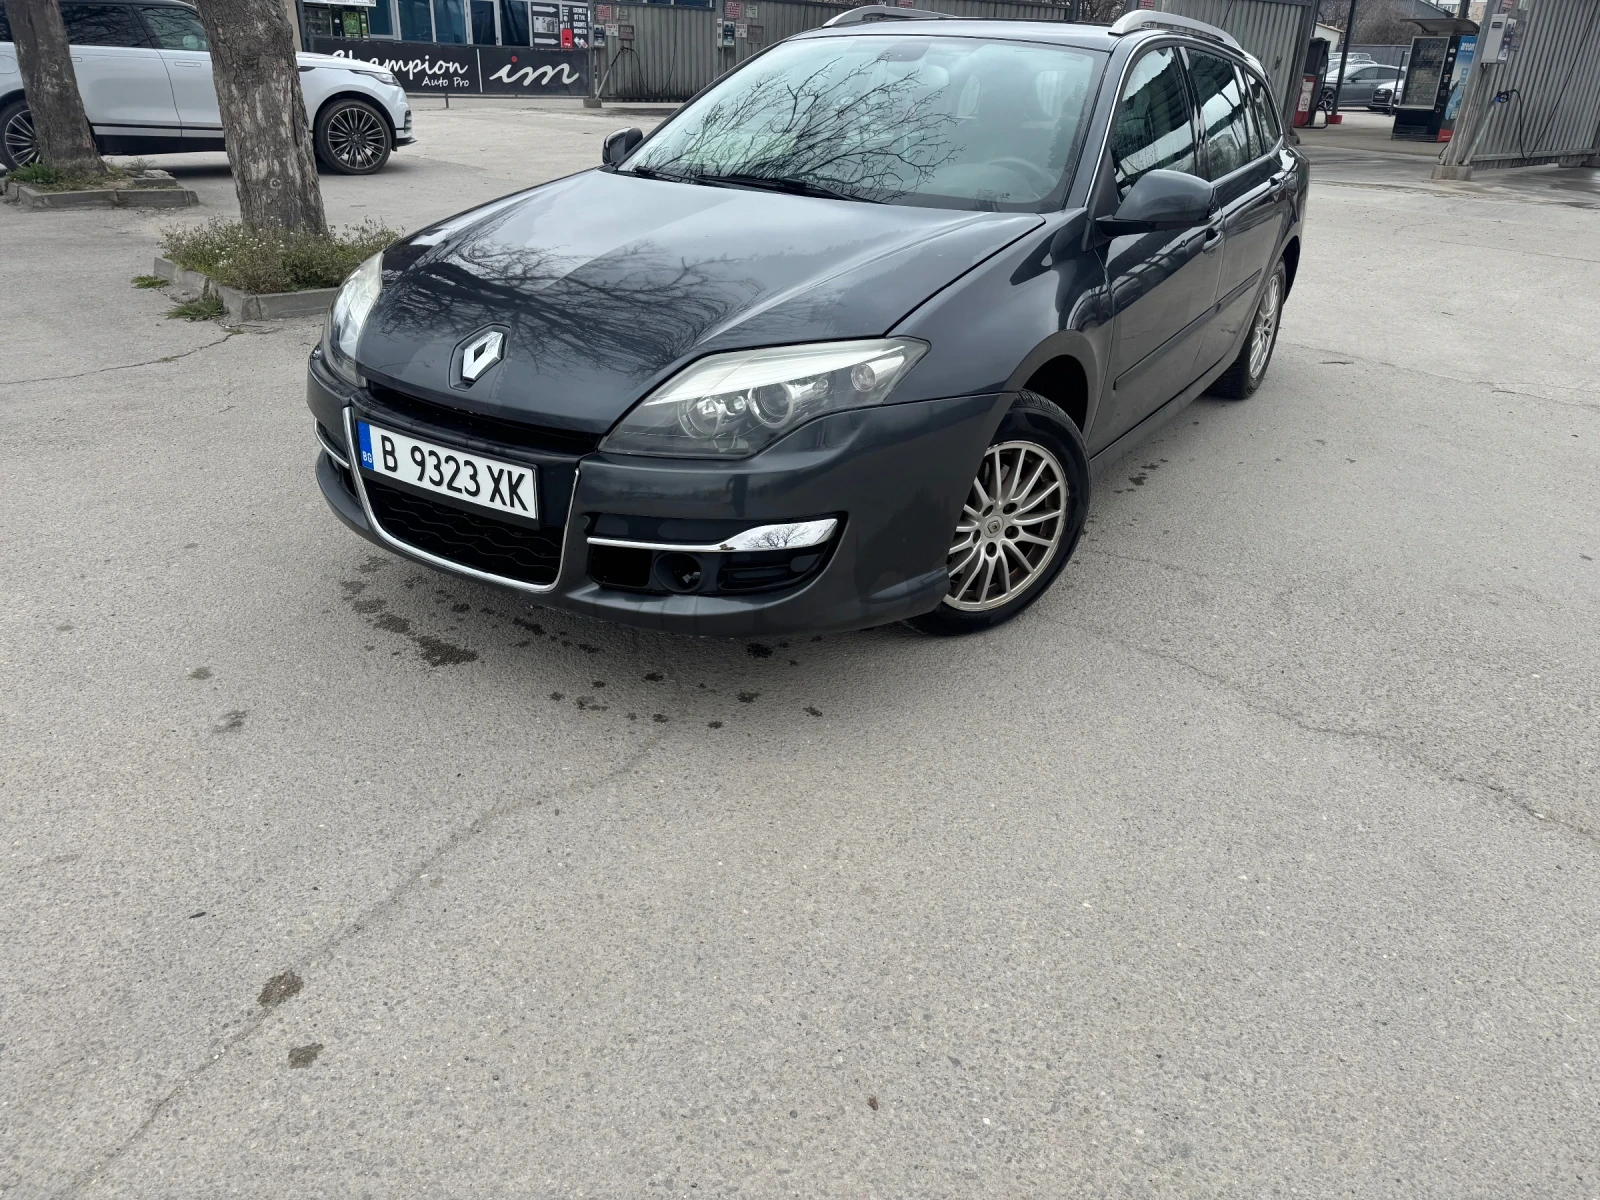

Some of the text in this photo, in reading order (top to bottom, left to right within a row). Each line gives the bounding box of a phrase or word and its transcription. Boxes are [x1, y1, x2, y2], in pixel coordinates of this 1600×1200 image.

[421, 76, 470, 88] Auto Pro
[362, 451, 373, 463] BG
[380, 434, 529, 512] B 9323 XK
